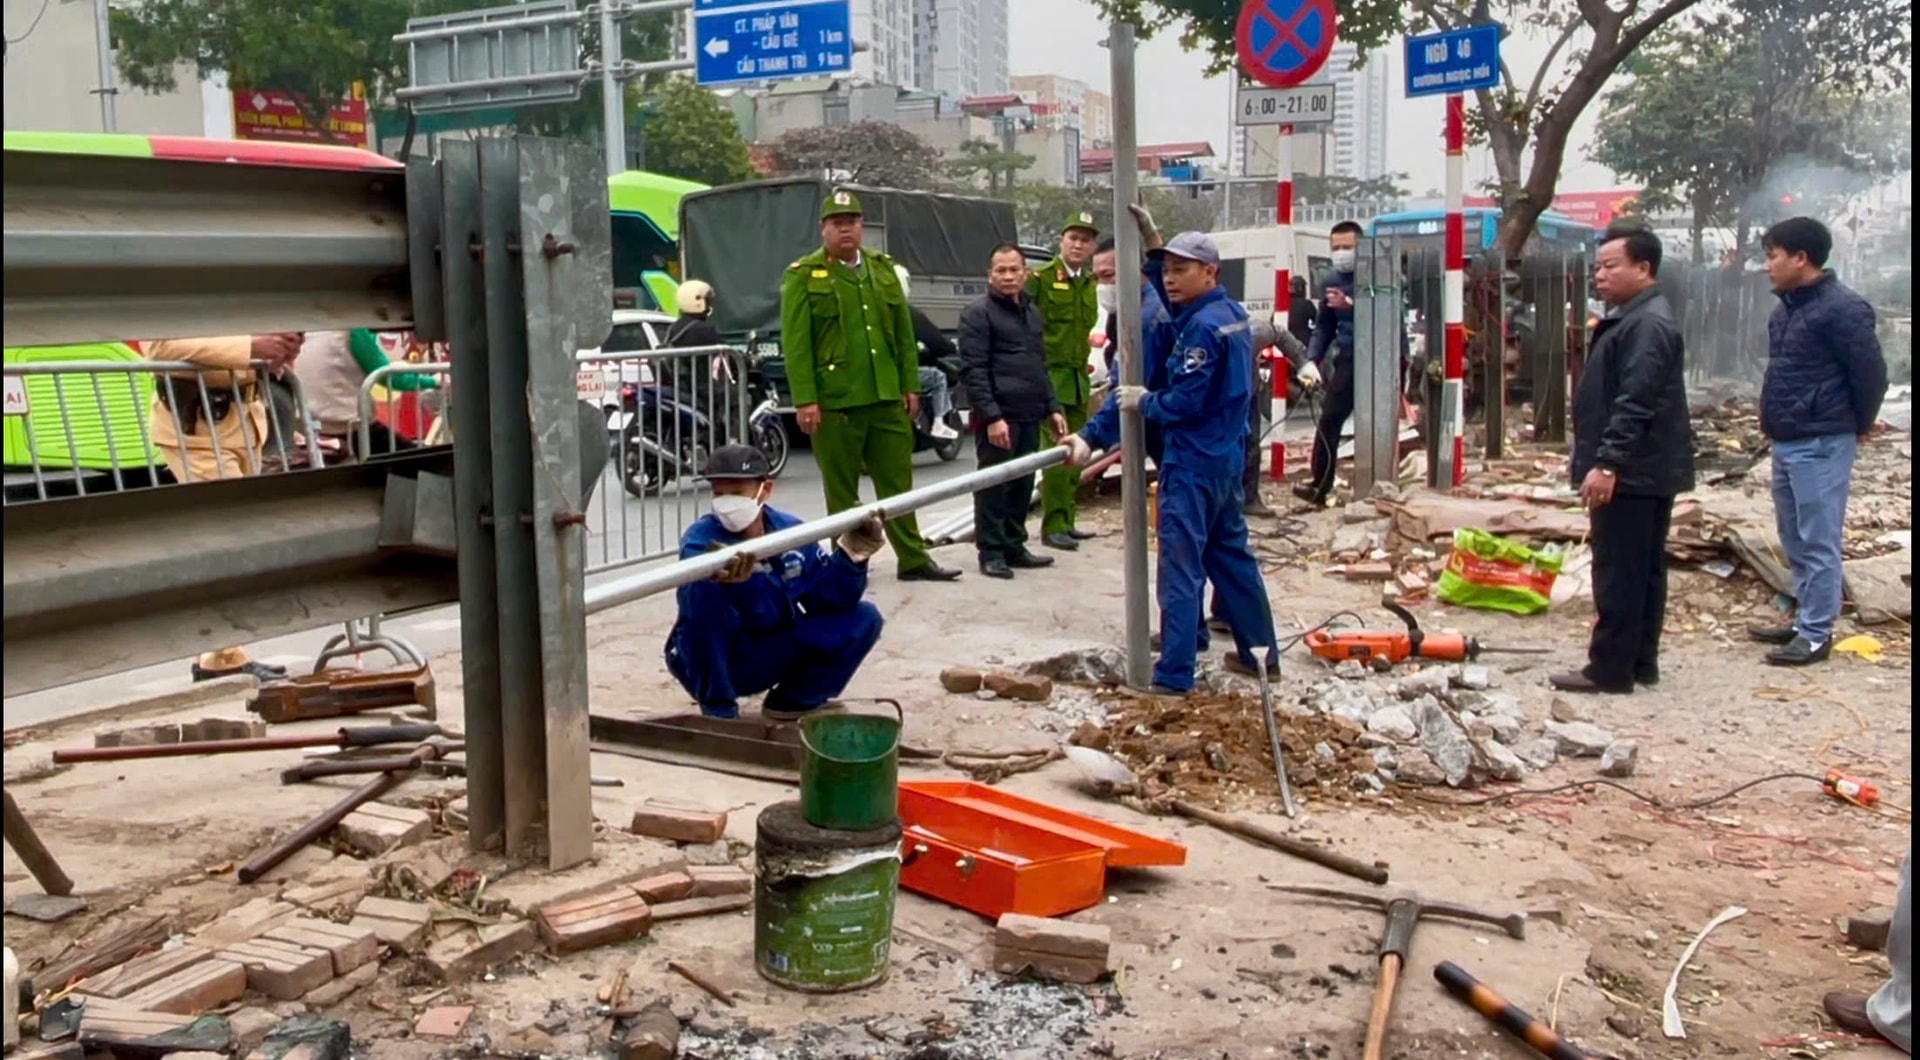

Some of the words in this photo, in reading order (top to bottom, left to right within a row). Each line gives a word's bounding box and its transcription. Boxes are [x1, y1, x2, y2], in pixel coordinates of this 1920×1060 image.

[752, 12, 776, 32] PHÁP
[819, 30, 825, 44] 1
[827, 29, 843, 44] km
[1457, 38, 1471, 58] 46
[758, 56, 788, 74] THANH
[818, 53, 825, 67] 9
[827, 52, 844, 66] km
